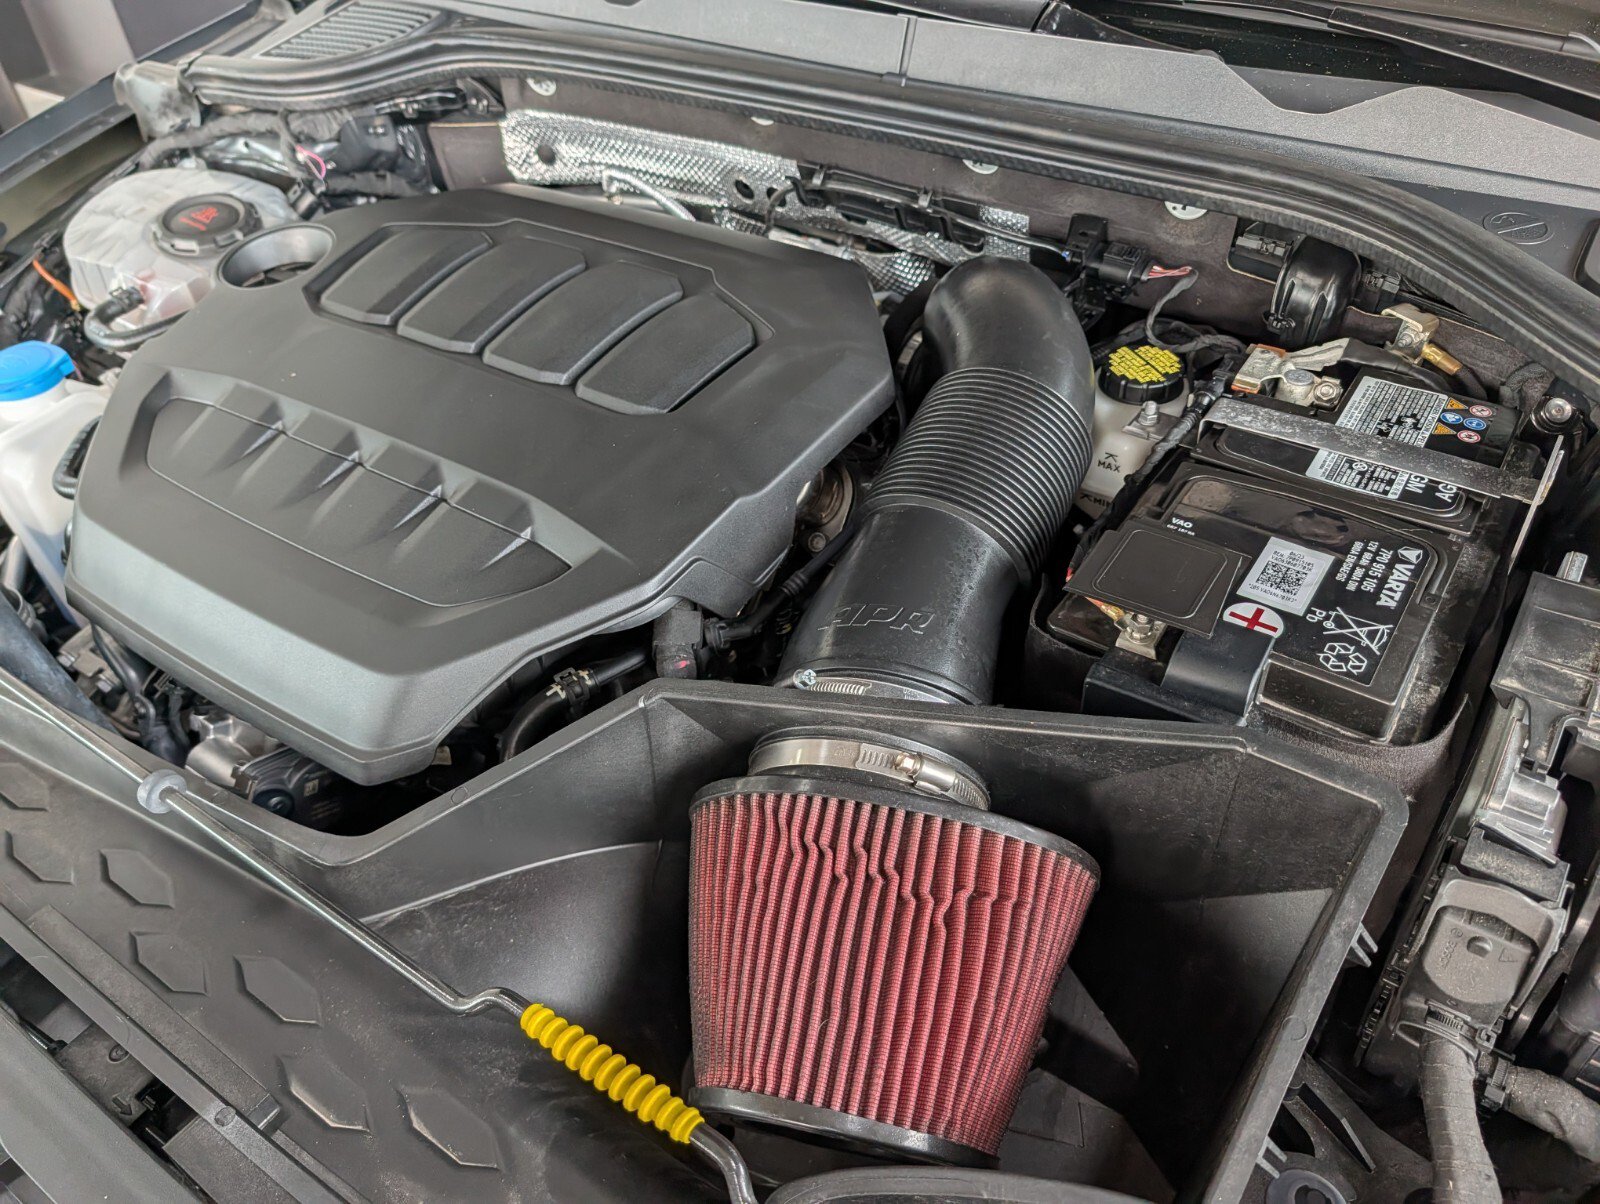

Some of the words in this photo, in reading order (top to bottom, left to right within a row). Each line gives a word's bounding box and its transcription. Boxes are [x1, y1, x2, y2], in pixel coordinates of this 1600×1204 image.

[1097, 460, 1120, 473] MAX
[1405, 474, 1428, 494] GM
[1435, 483, 1458, 502] AG
[1367, 541, 1379, 552] 12V
[1376, 548, 1394, 564] 7P0
[1368, 562, 1386, 578] 915
[1361, 578, 1378, 593] 105
[1376, 563, 1415, 607] VARTA
[818, 603, 936, 635] APR
[1306, 607, 1326, 622] Pb
